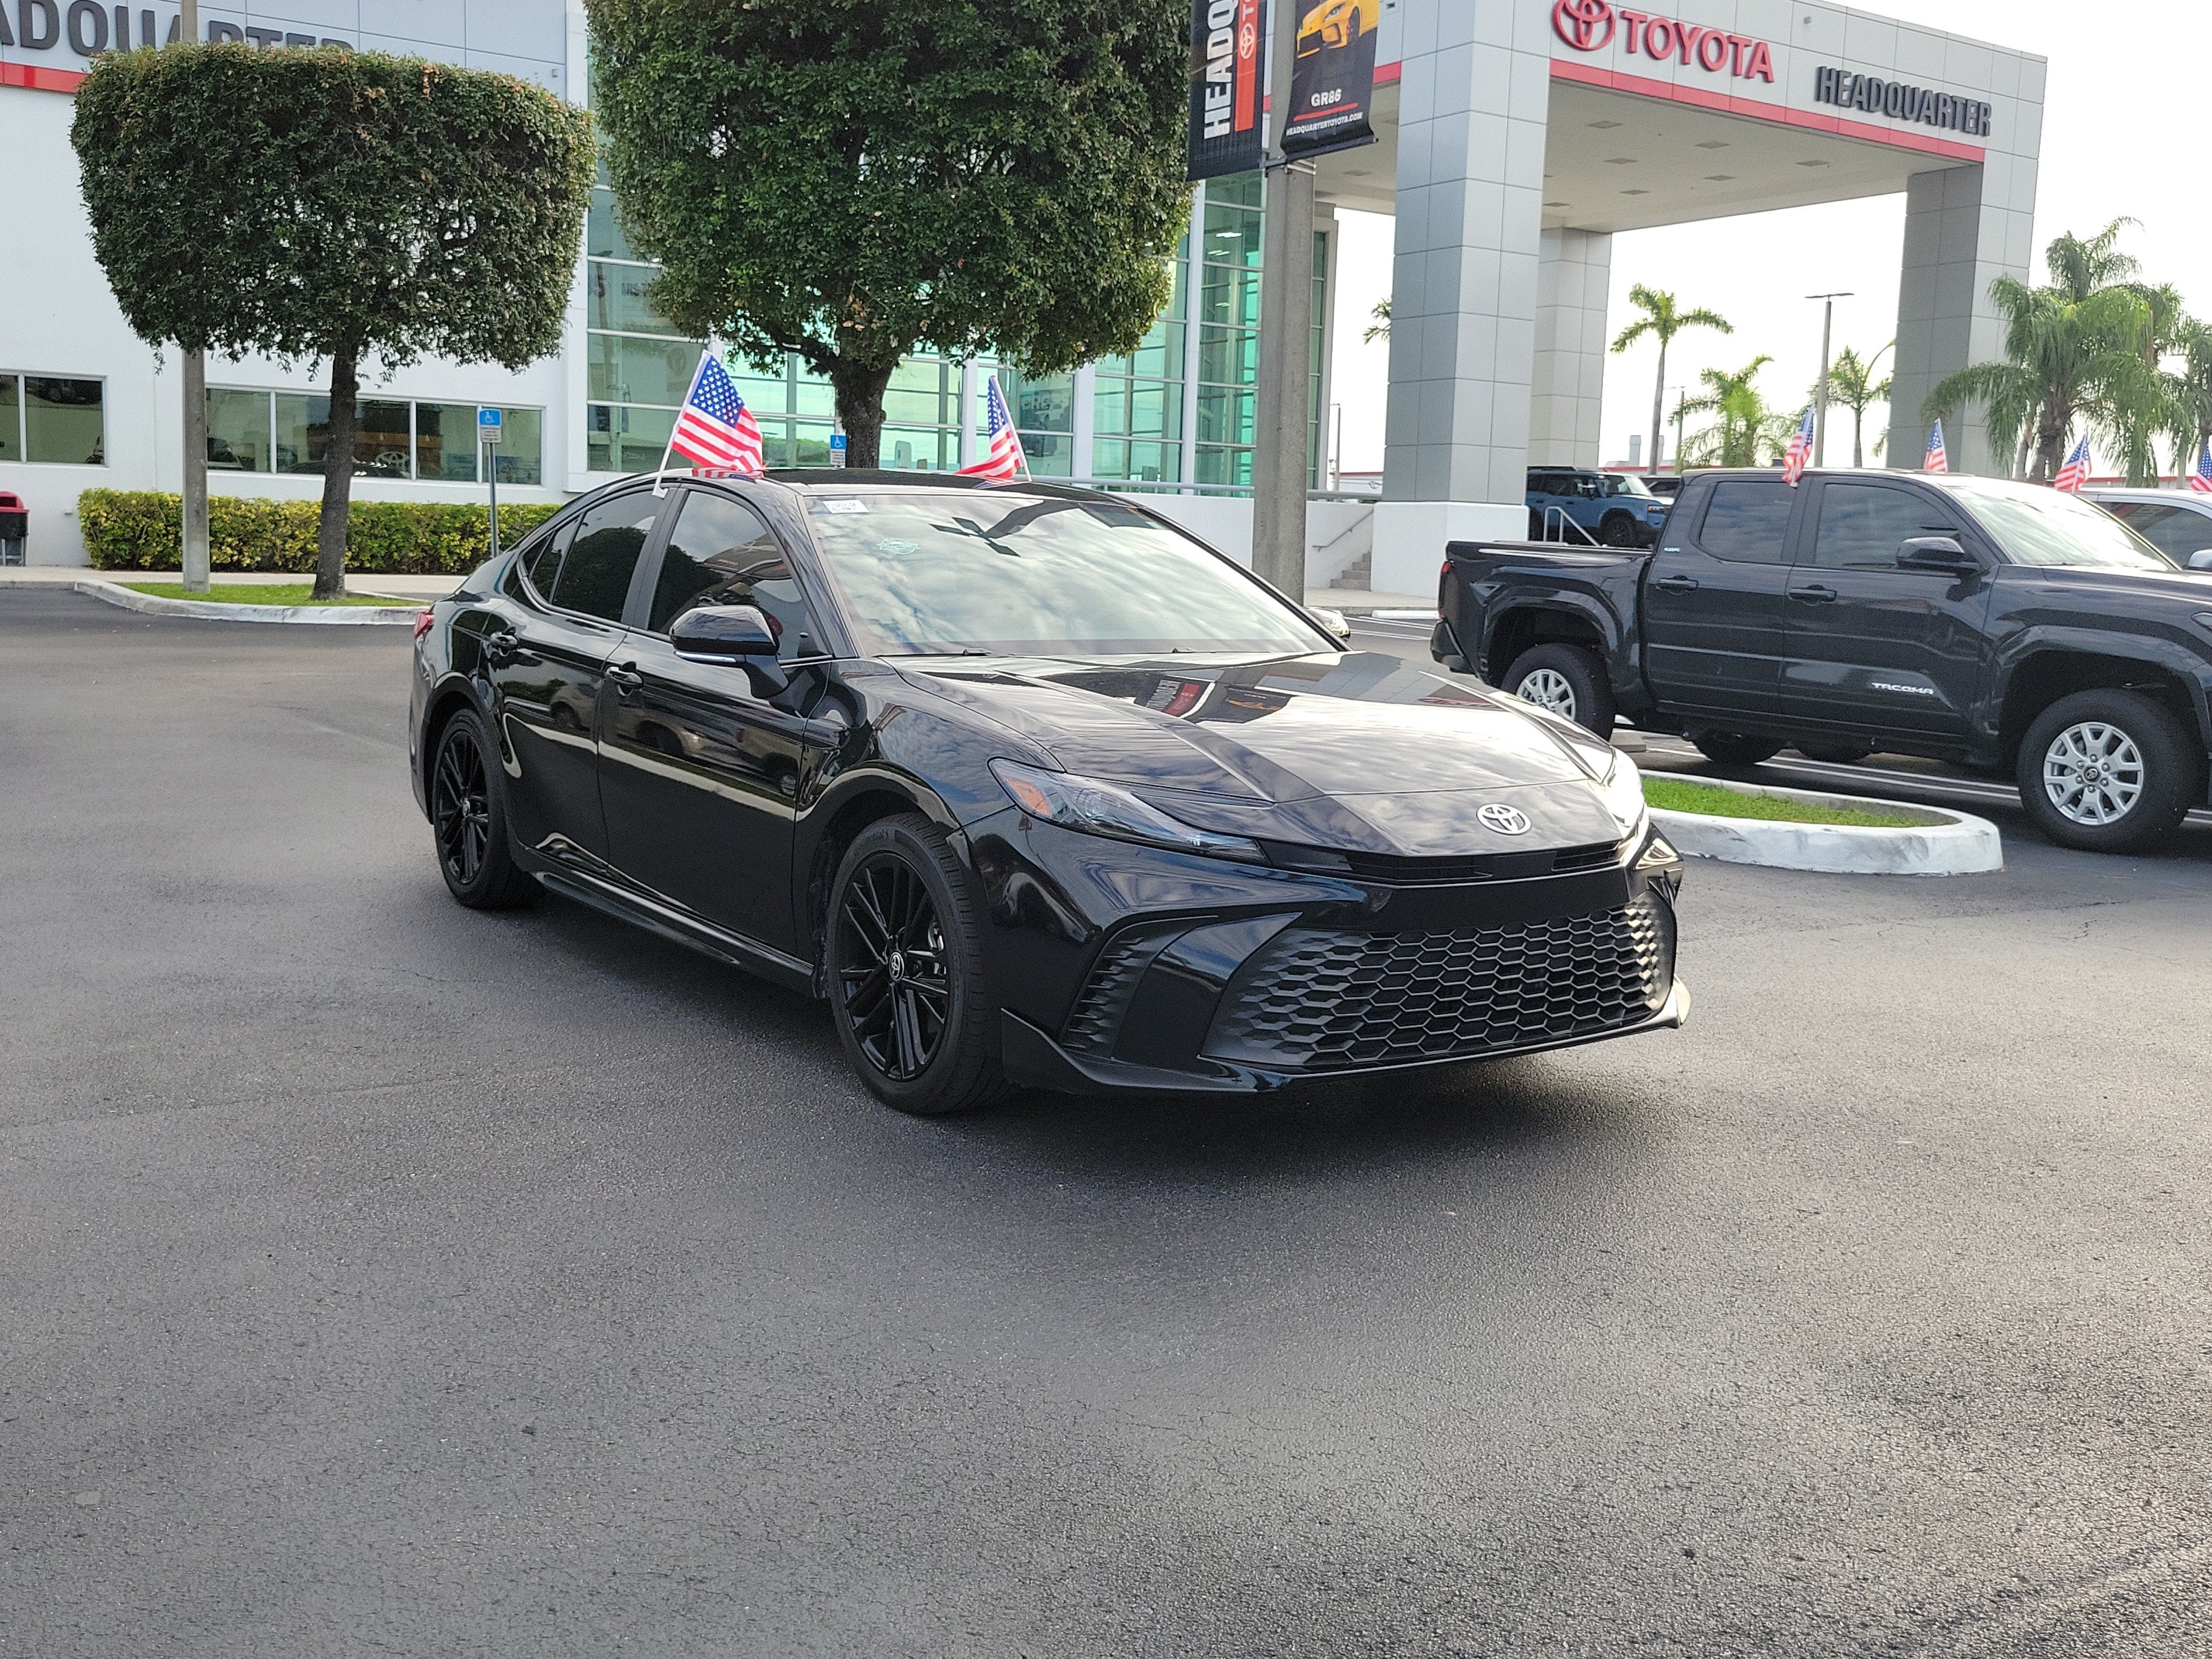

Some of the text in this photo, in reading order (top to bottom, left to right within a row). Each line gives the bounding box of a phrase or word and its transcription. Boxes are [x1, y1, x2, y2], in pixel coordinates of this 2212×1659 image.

[1204, 0, 1239, 139] HEADQ
[1621, 10, 1774, 83] TOYOTA
[1311, 88, 1342, 107] GR86
[1814, 66, 1992, 137] HEADQUARTER
[1285, 112, 1364, 136] HEADQUARTERTOYOTA.COM
[1871, 682, 1934, 695] TACOMA
